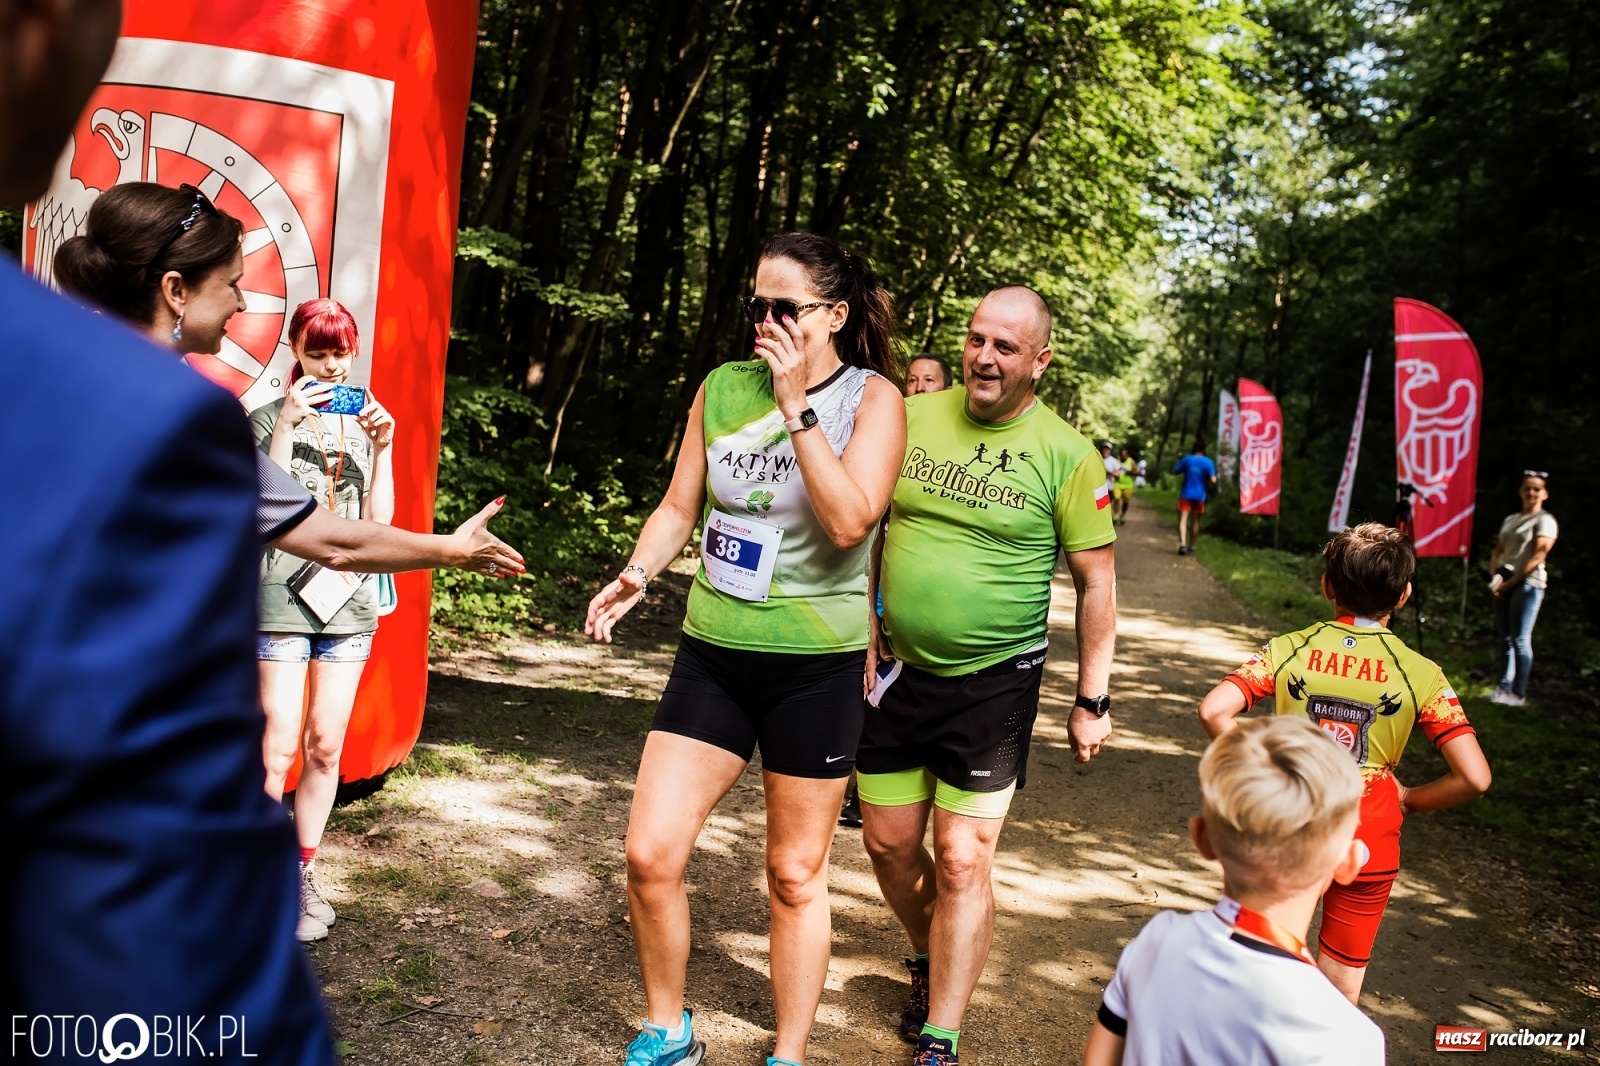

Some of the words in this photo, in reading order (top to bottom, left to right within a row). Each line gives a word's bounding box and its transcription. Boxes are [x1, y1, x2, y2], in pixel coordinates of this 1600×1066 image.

[732, 468, 790, 483] LYSKI
[901, 446, 1027, 510] Radlinioki
[922, 485, 937, 496] w
[939, 490, 989, 510] biegu
[715, 535, 742, 562] 38
[1306, 649, 1389, 684] RAFAŁ
